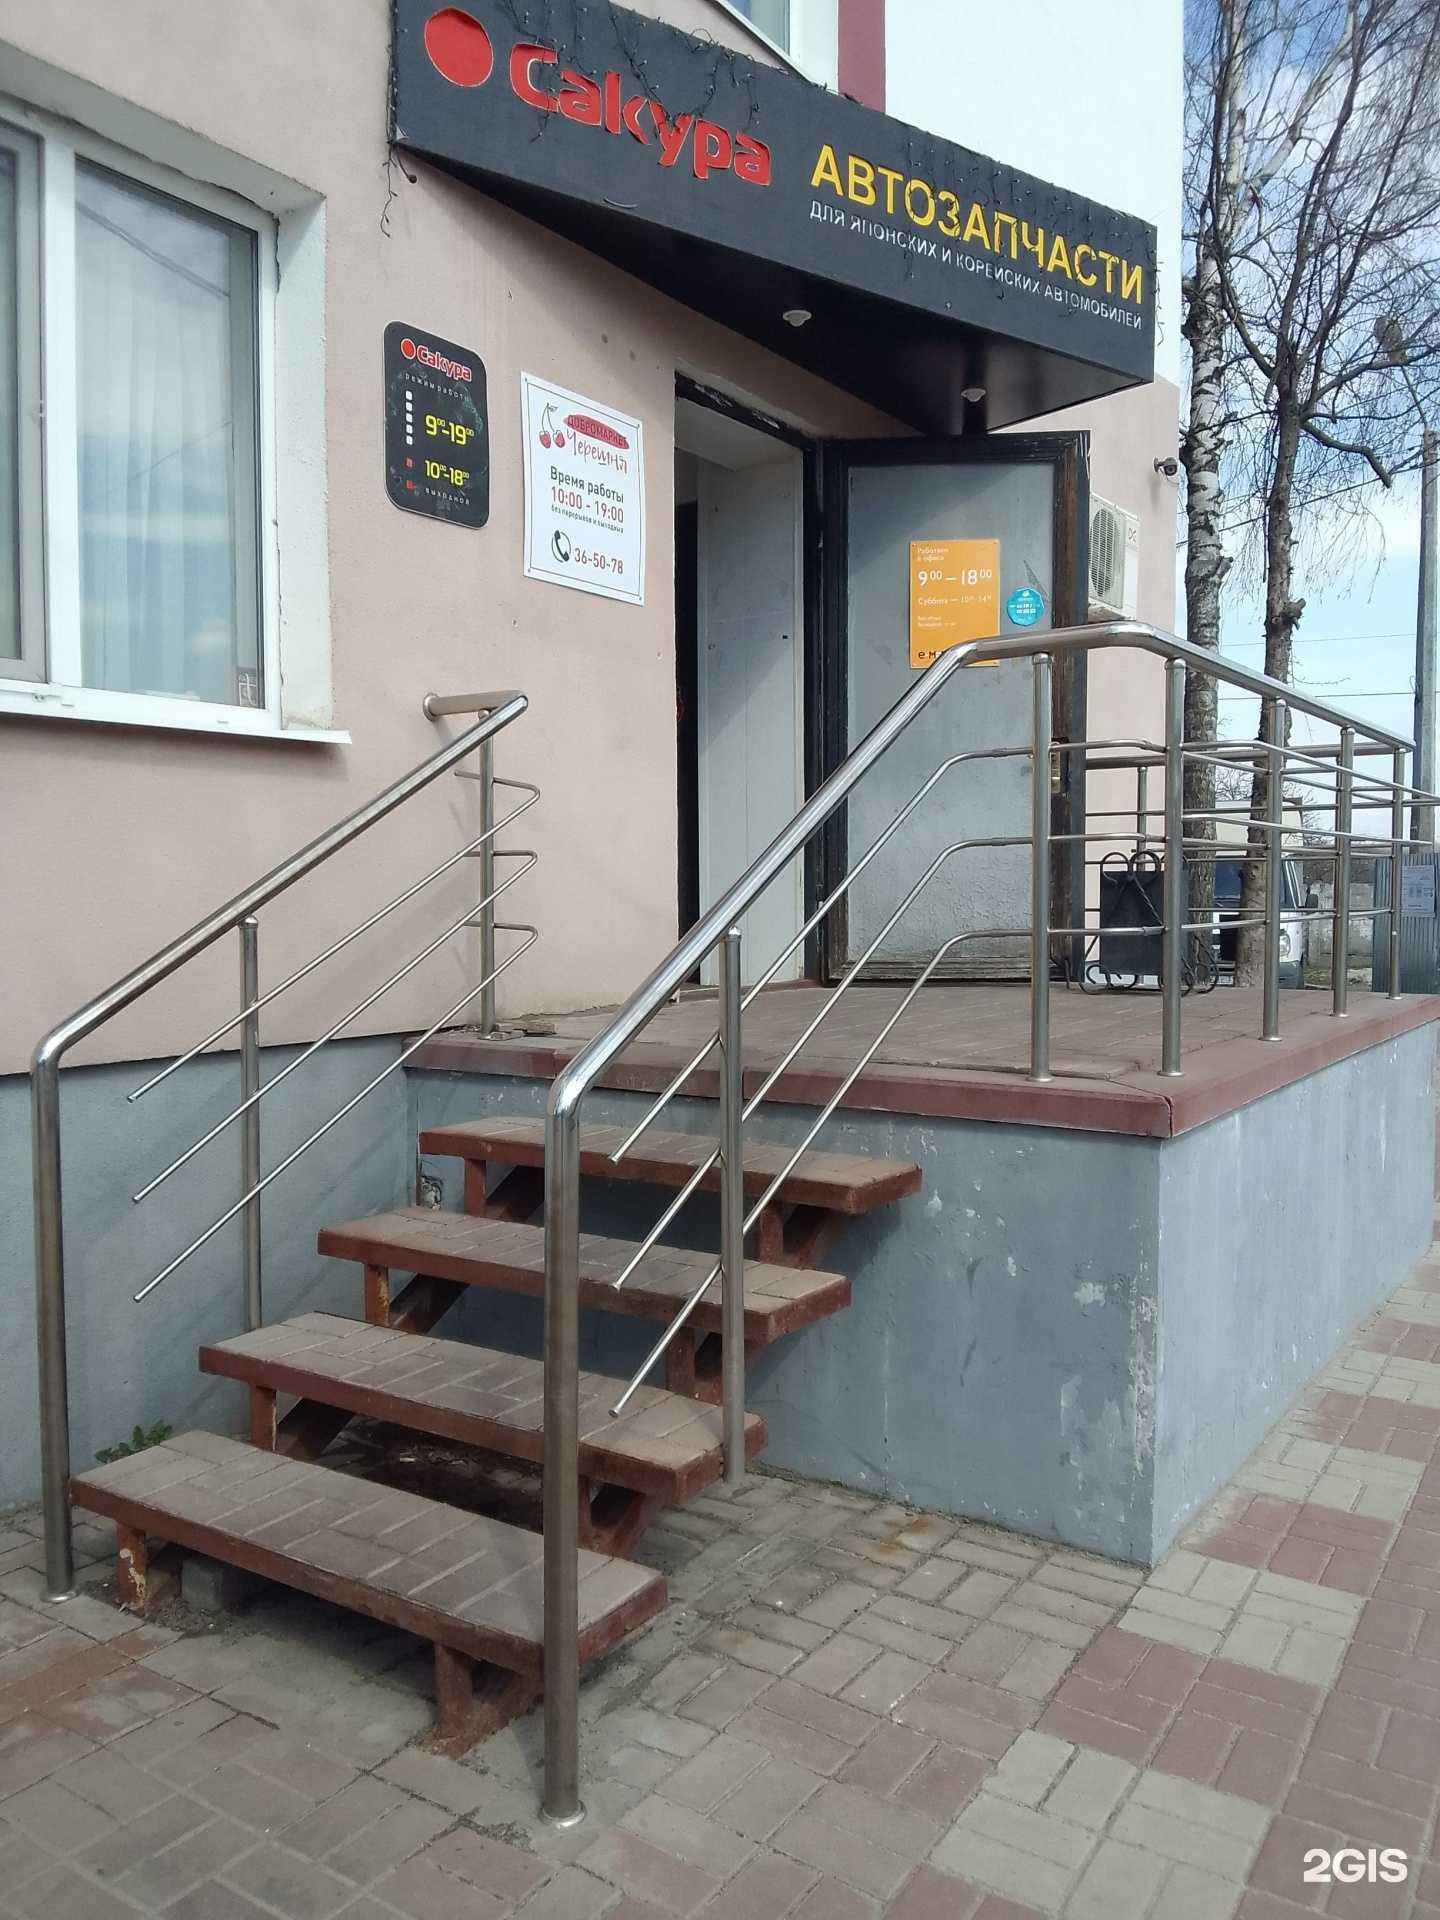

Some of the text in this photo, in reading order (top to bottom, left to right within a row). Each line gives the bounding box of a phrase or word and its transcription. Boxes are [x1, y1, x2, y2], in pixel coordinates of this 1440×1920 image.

[509, 42, 771, 186] Сакура
[810, 144, 1143, 305] АВТОЗАПЧАСТИ
[809, 200, 1143, 330] ДЛЯ ЯПОНСКИХ И КОРЕЙСКИХ АВТОМОБИЛЕЙ
[416, 345, 472, 382] Сакура
[550, 465, 624, 504] Время работы
[551, 486, 583, 509] 10:00
[594, 500, 624, 523] 19:00
[574, 547, 624, 574] 36-50-78
